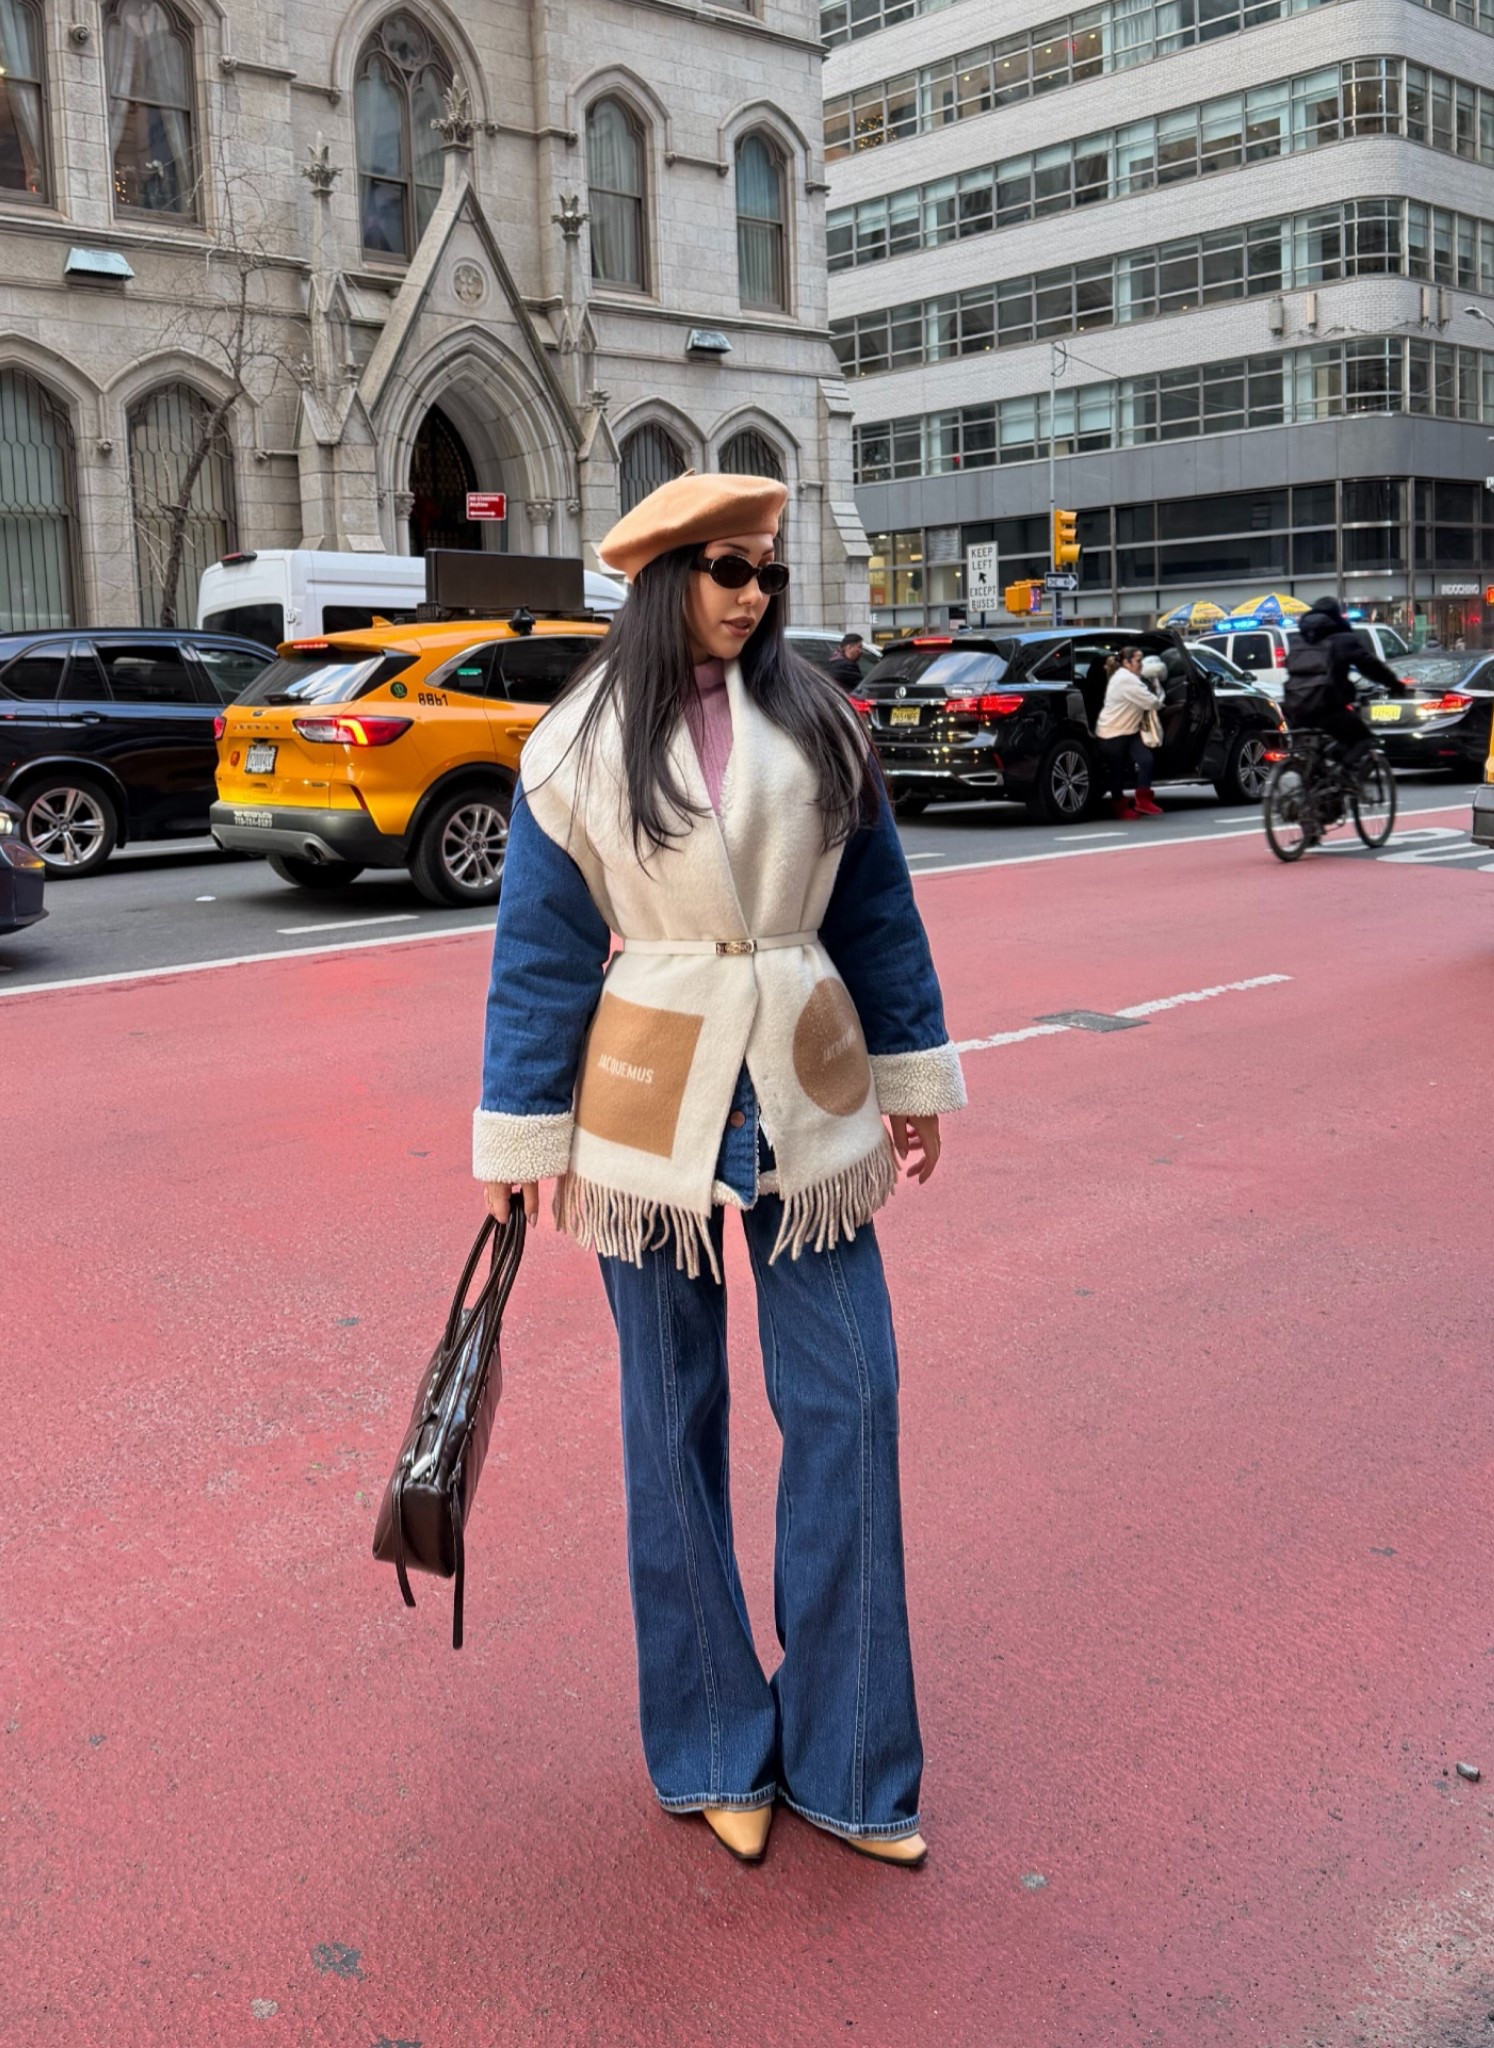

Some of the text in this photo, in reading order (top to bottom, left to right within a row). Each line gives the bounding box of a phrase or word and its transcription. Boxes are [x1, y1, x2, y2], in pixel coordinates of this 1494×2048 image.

[971, 547, 993, 558] KEEP
[972, 560, 992, 571] LEFT
[969, 586, 996, 598] EXCEPT
[971, 598, 995, 609] BUSES
[597, 1054, 654, 1084] JACQUEMUS
